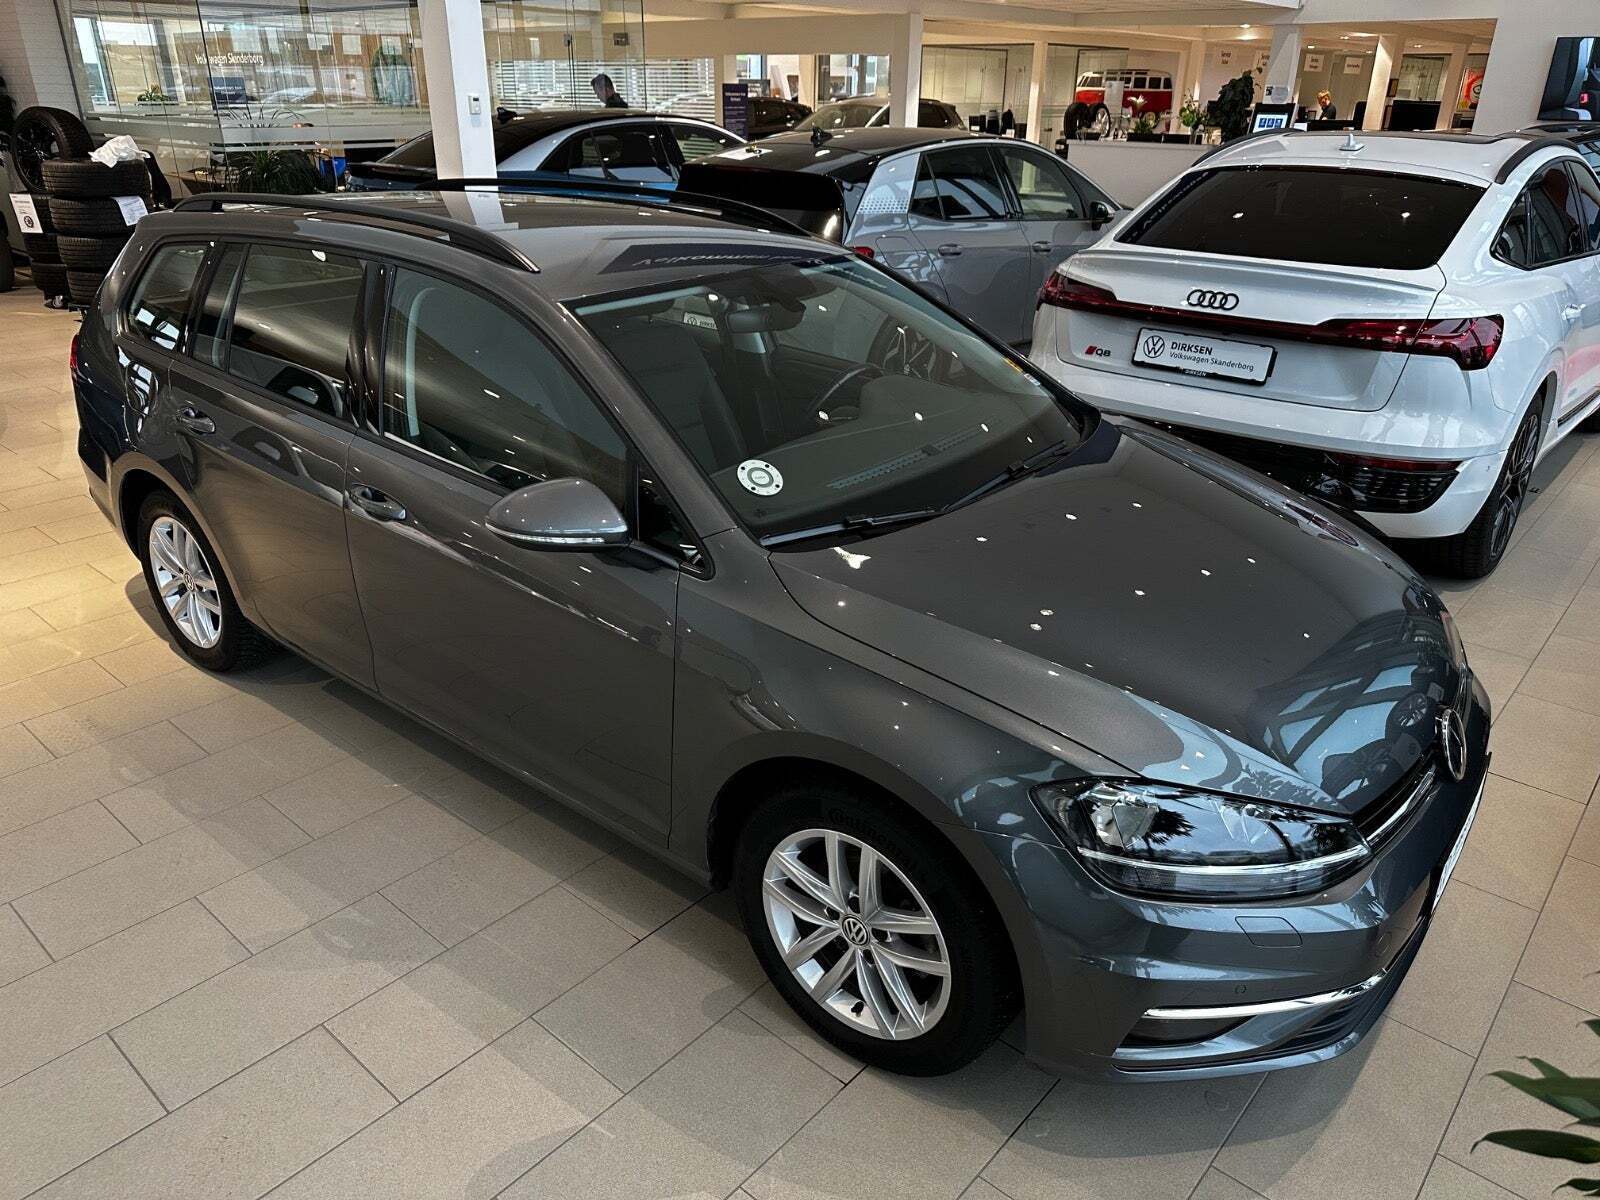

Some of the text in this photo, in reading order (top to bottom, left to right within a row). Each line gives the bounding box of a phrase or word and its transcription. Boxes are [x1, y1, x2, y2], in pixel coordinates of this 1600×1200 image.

[228, 53, 264, 66] Skanderborg
[1171, 341, 1213, 356] DIRKSEN
[1169, 351, 1254, 372] Volkswagen Skanderborg
